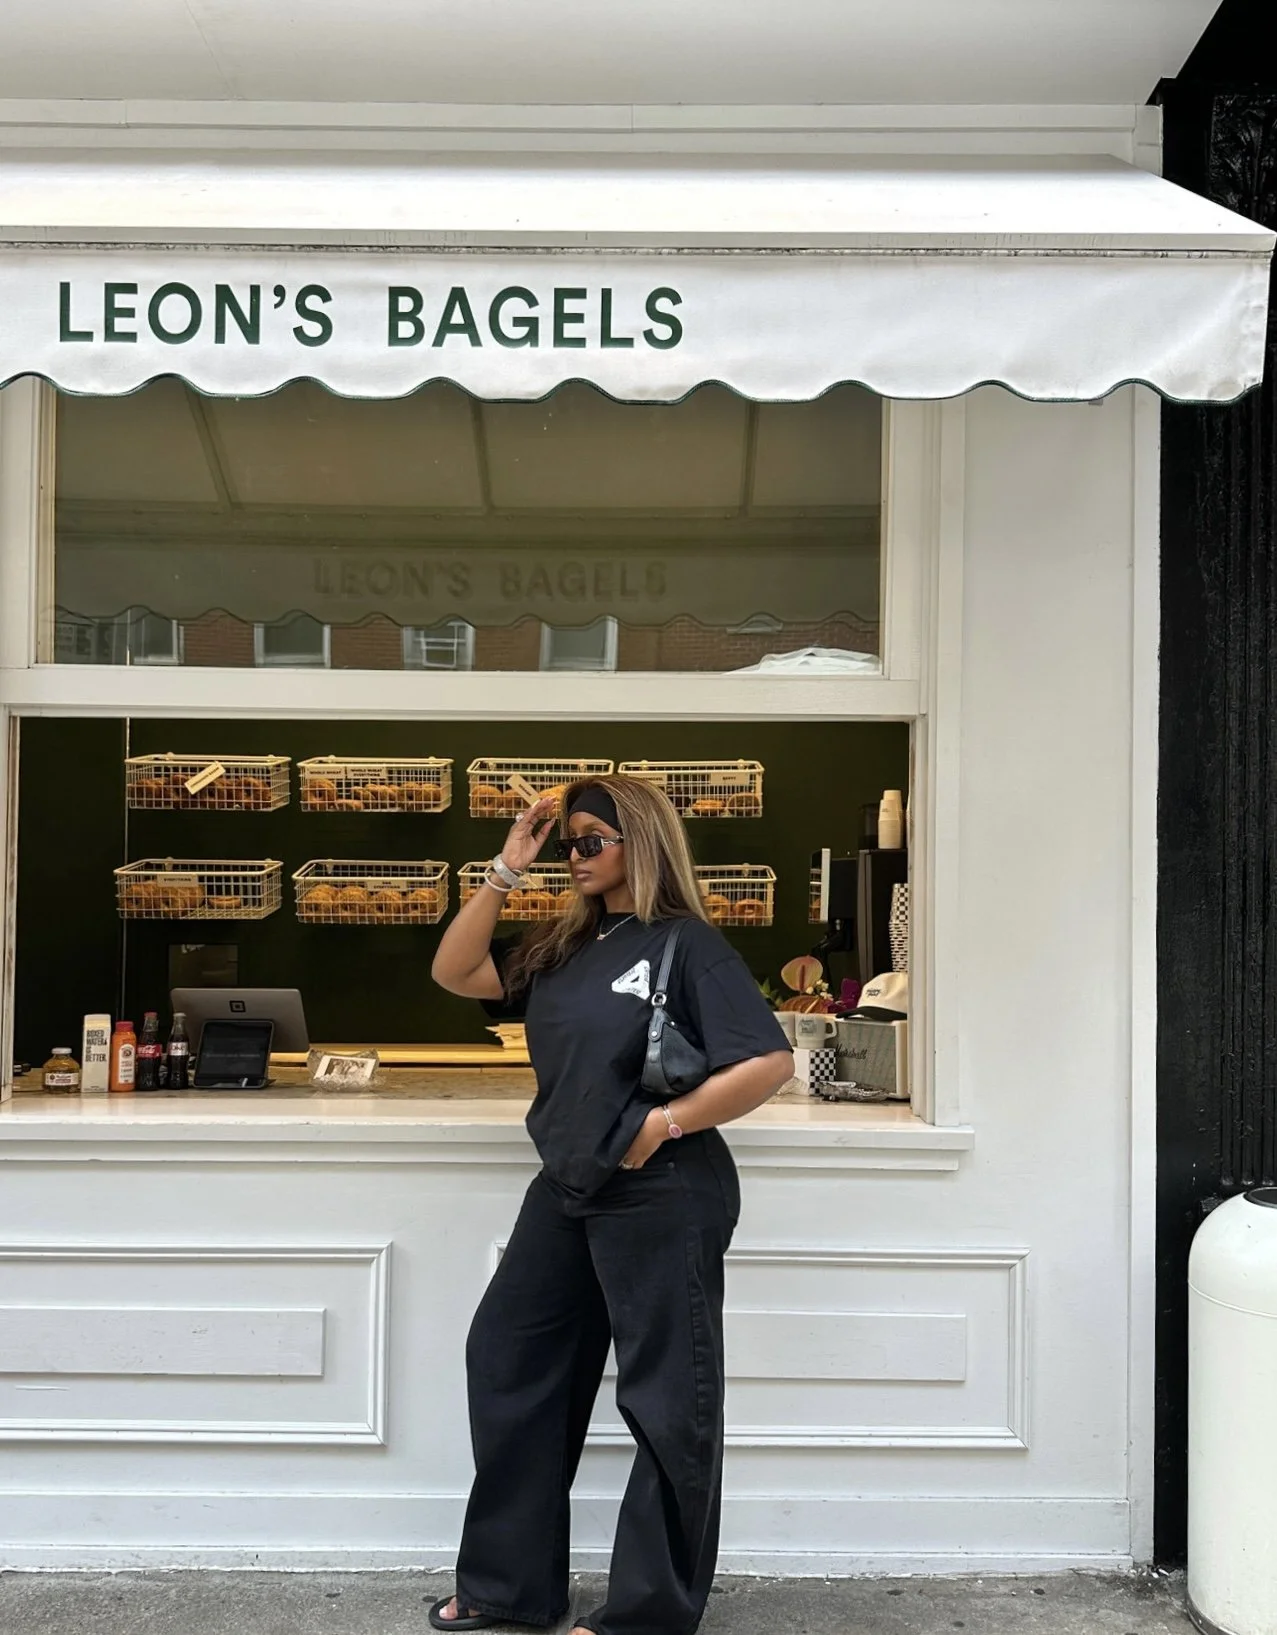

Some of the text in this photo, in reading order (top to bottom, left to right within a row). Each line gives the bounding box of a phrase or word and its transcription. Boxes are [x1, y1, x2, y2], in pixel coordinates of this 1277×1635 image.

[59, 281, 683, 349] LEON'S BAGELS
[86, 1029, 105, 1038] BOXED
